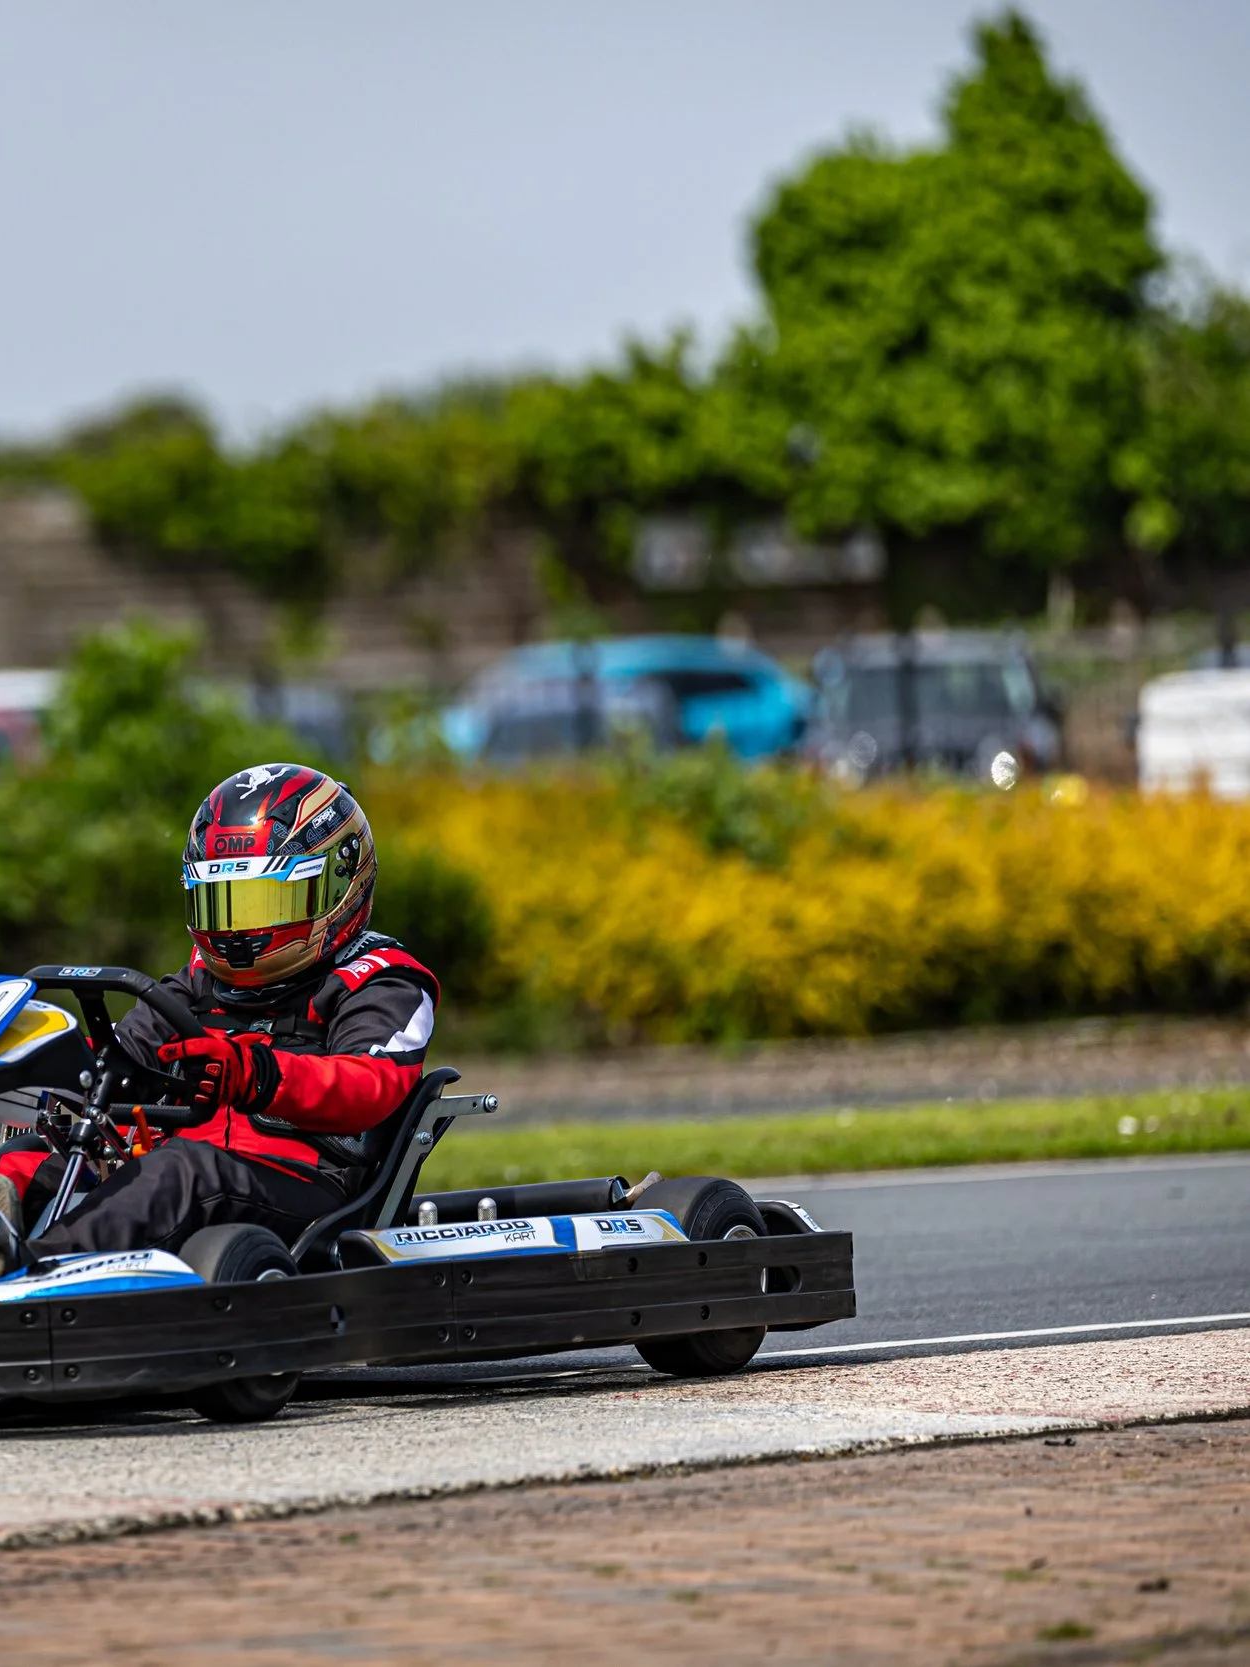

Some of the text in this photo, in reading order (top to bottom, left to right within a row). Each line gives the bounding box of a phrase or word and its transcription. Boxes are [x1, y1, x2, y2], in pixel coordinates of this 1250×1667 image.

[214, 837, 255, 853] OMP
[209, 861, 249, 875] DRS
[59, 967, 102, 977] DRS
[395, 1220, 533, 1245] RICCIARDO
[593, 1218, 645, 1233] DRS
[504, 1230, 536, 1243] KART
